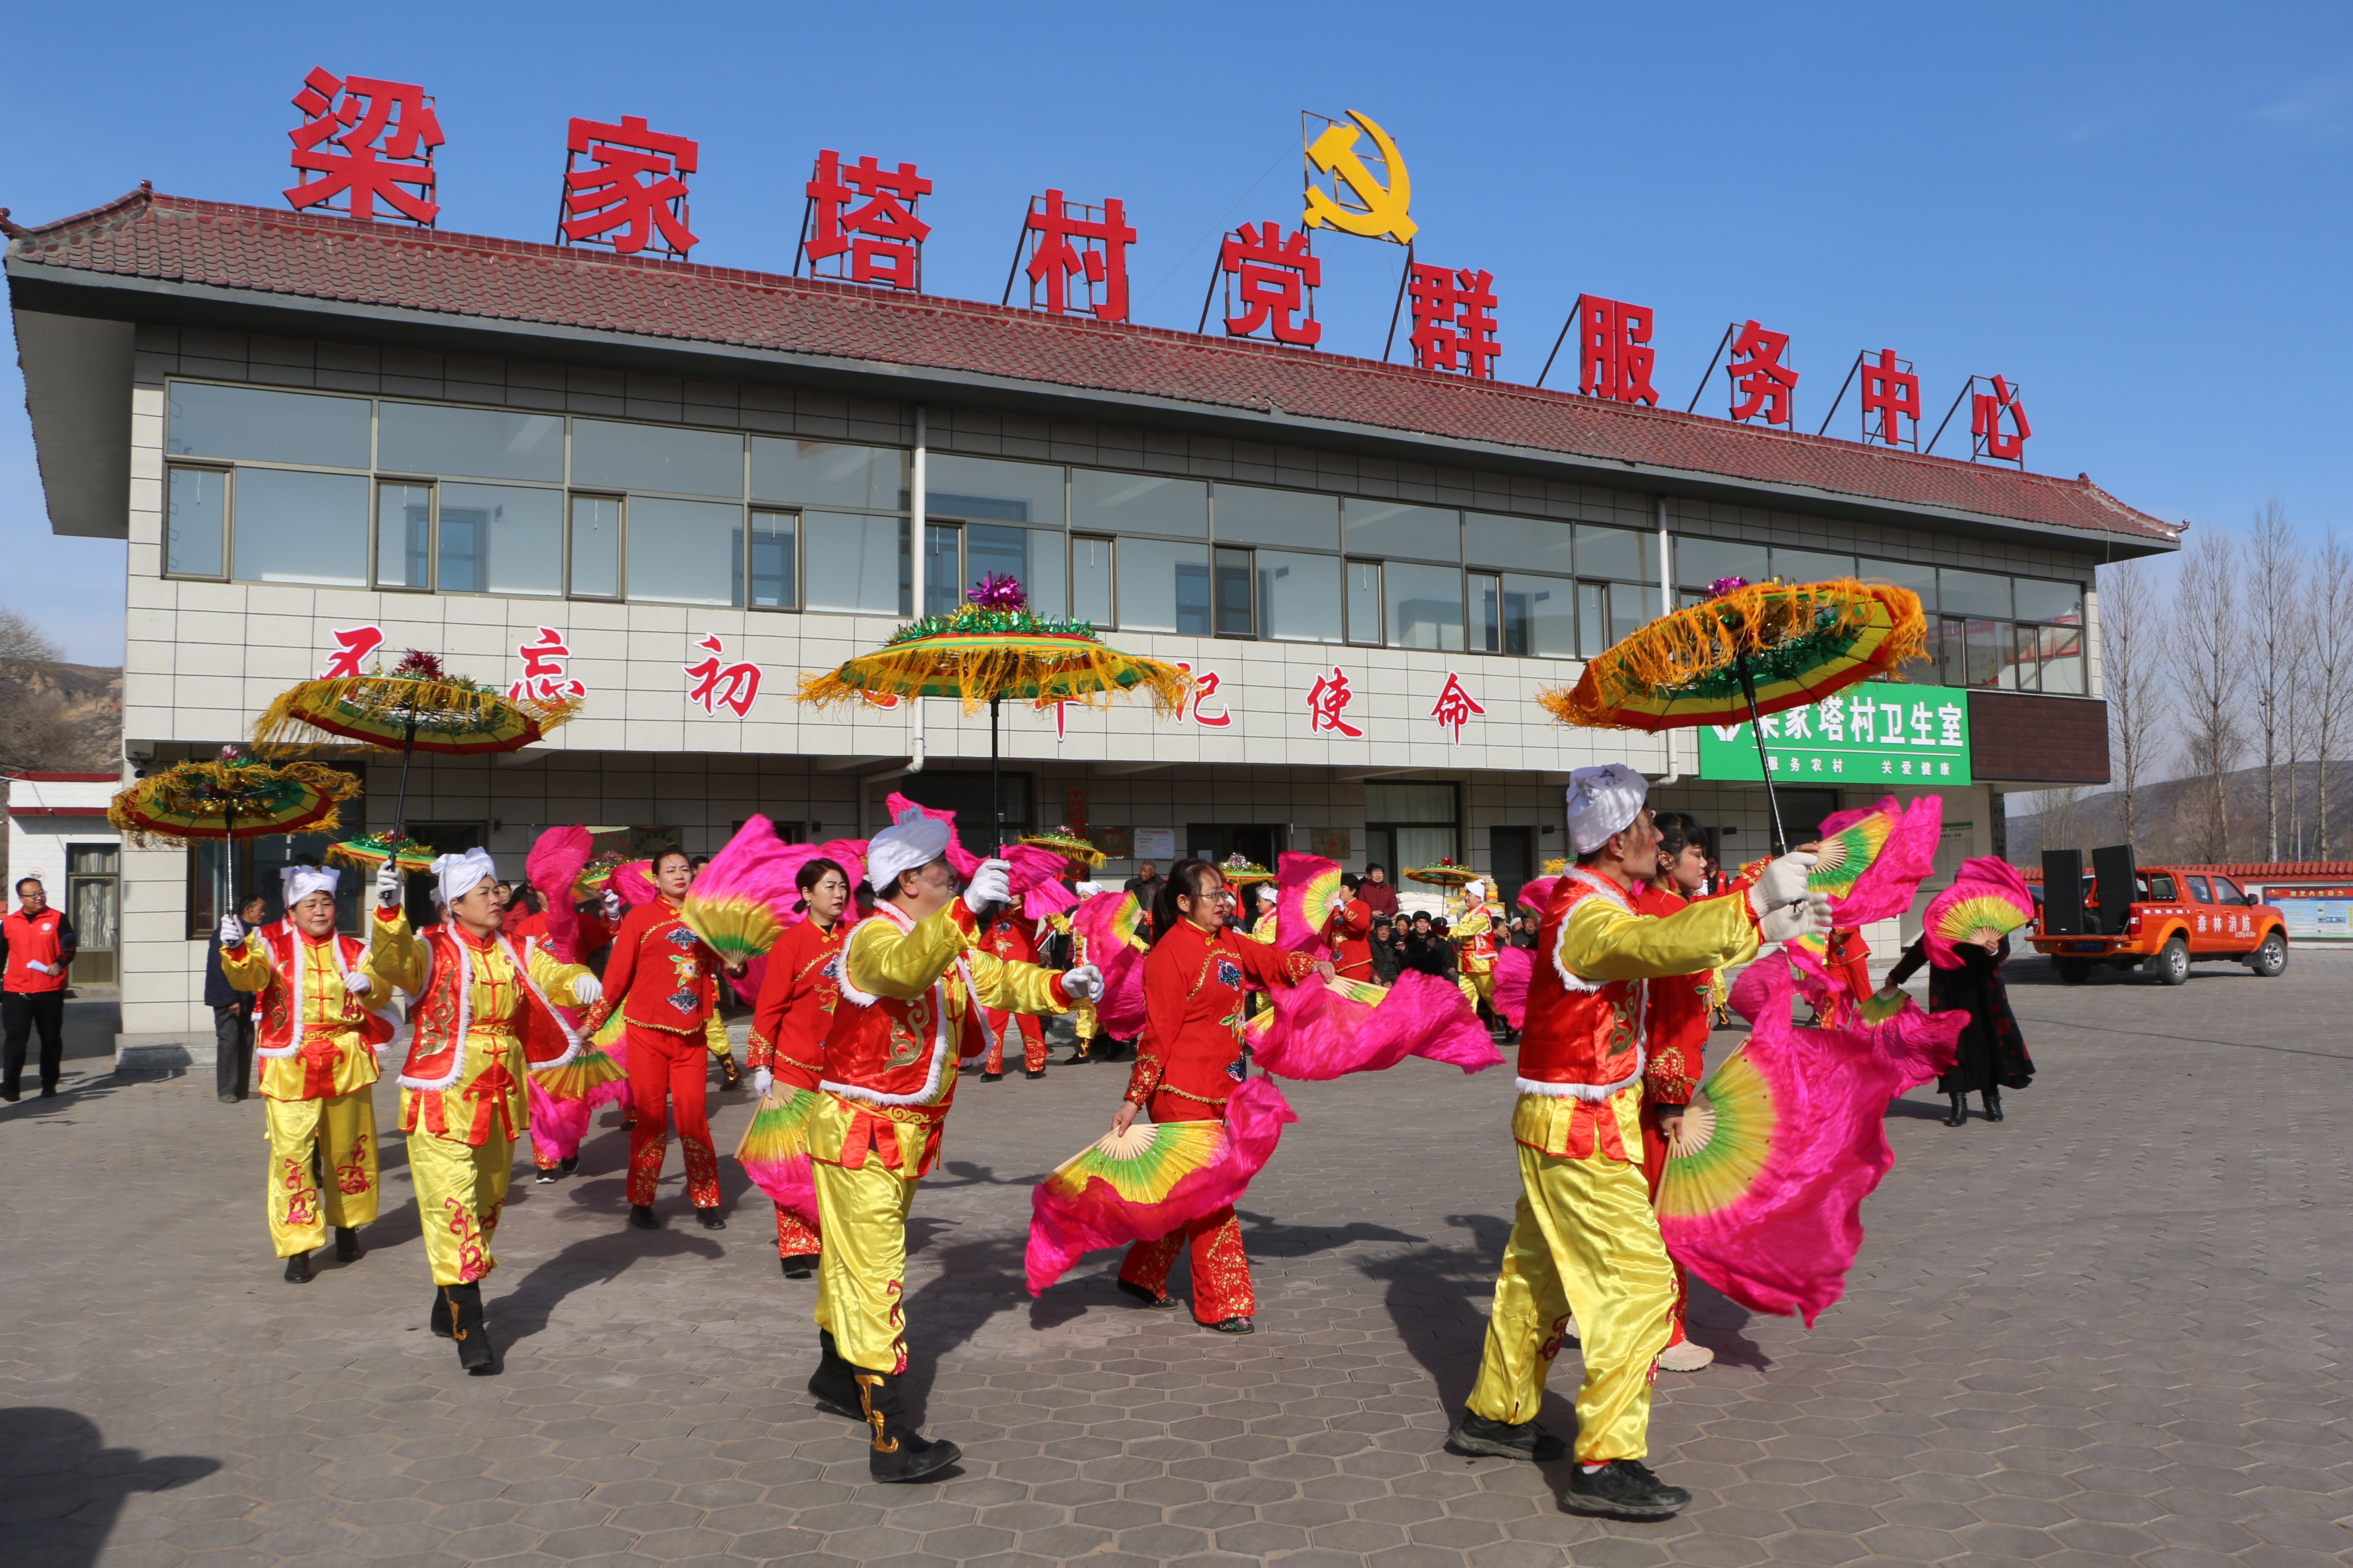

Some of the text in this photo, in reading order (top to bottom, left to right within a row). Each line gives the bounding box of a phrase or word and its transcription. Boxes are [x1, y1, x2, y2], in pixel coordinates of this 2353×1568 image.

[283, 65, 2032, 460] 梁家塔村党群服务中心
[1767, 756, 1950, 776] 服务农村 关爱健康
[2197, 914, 2250, 932] 森林消防
